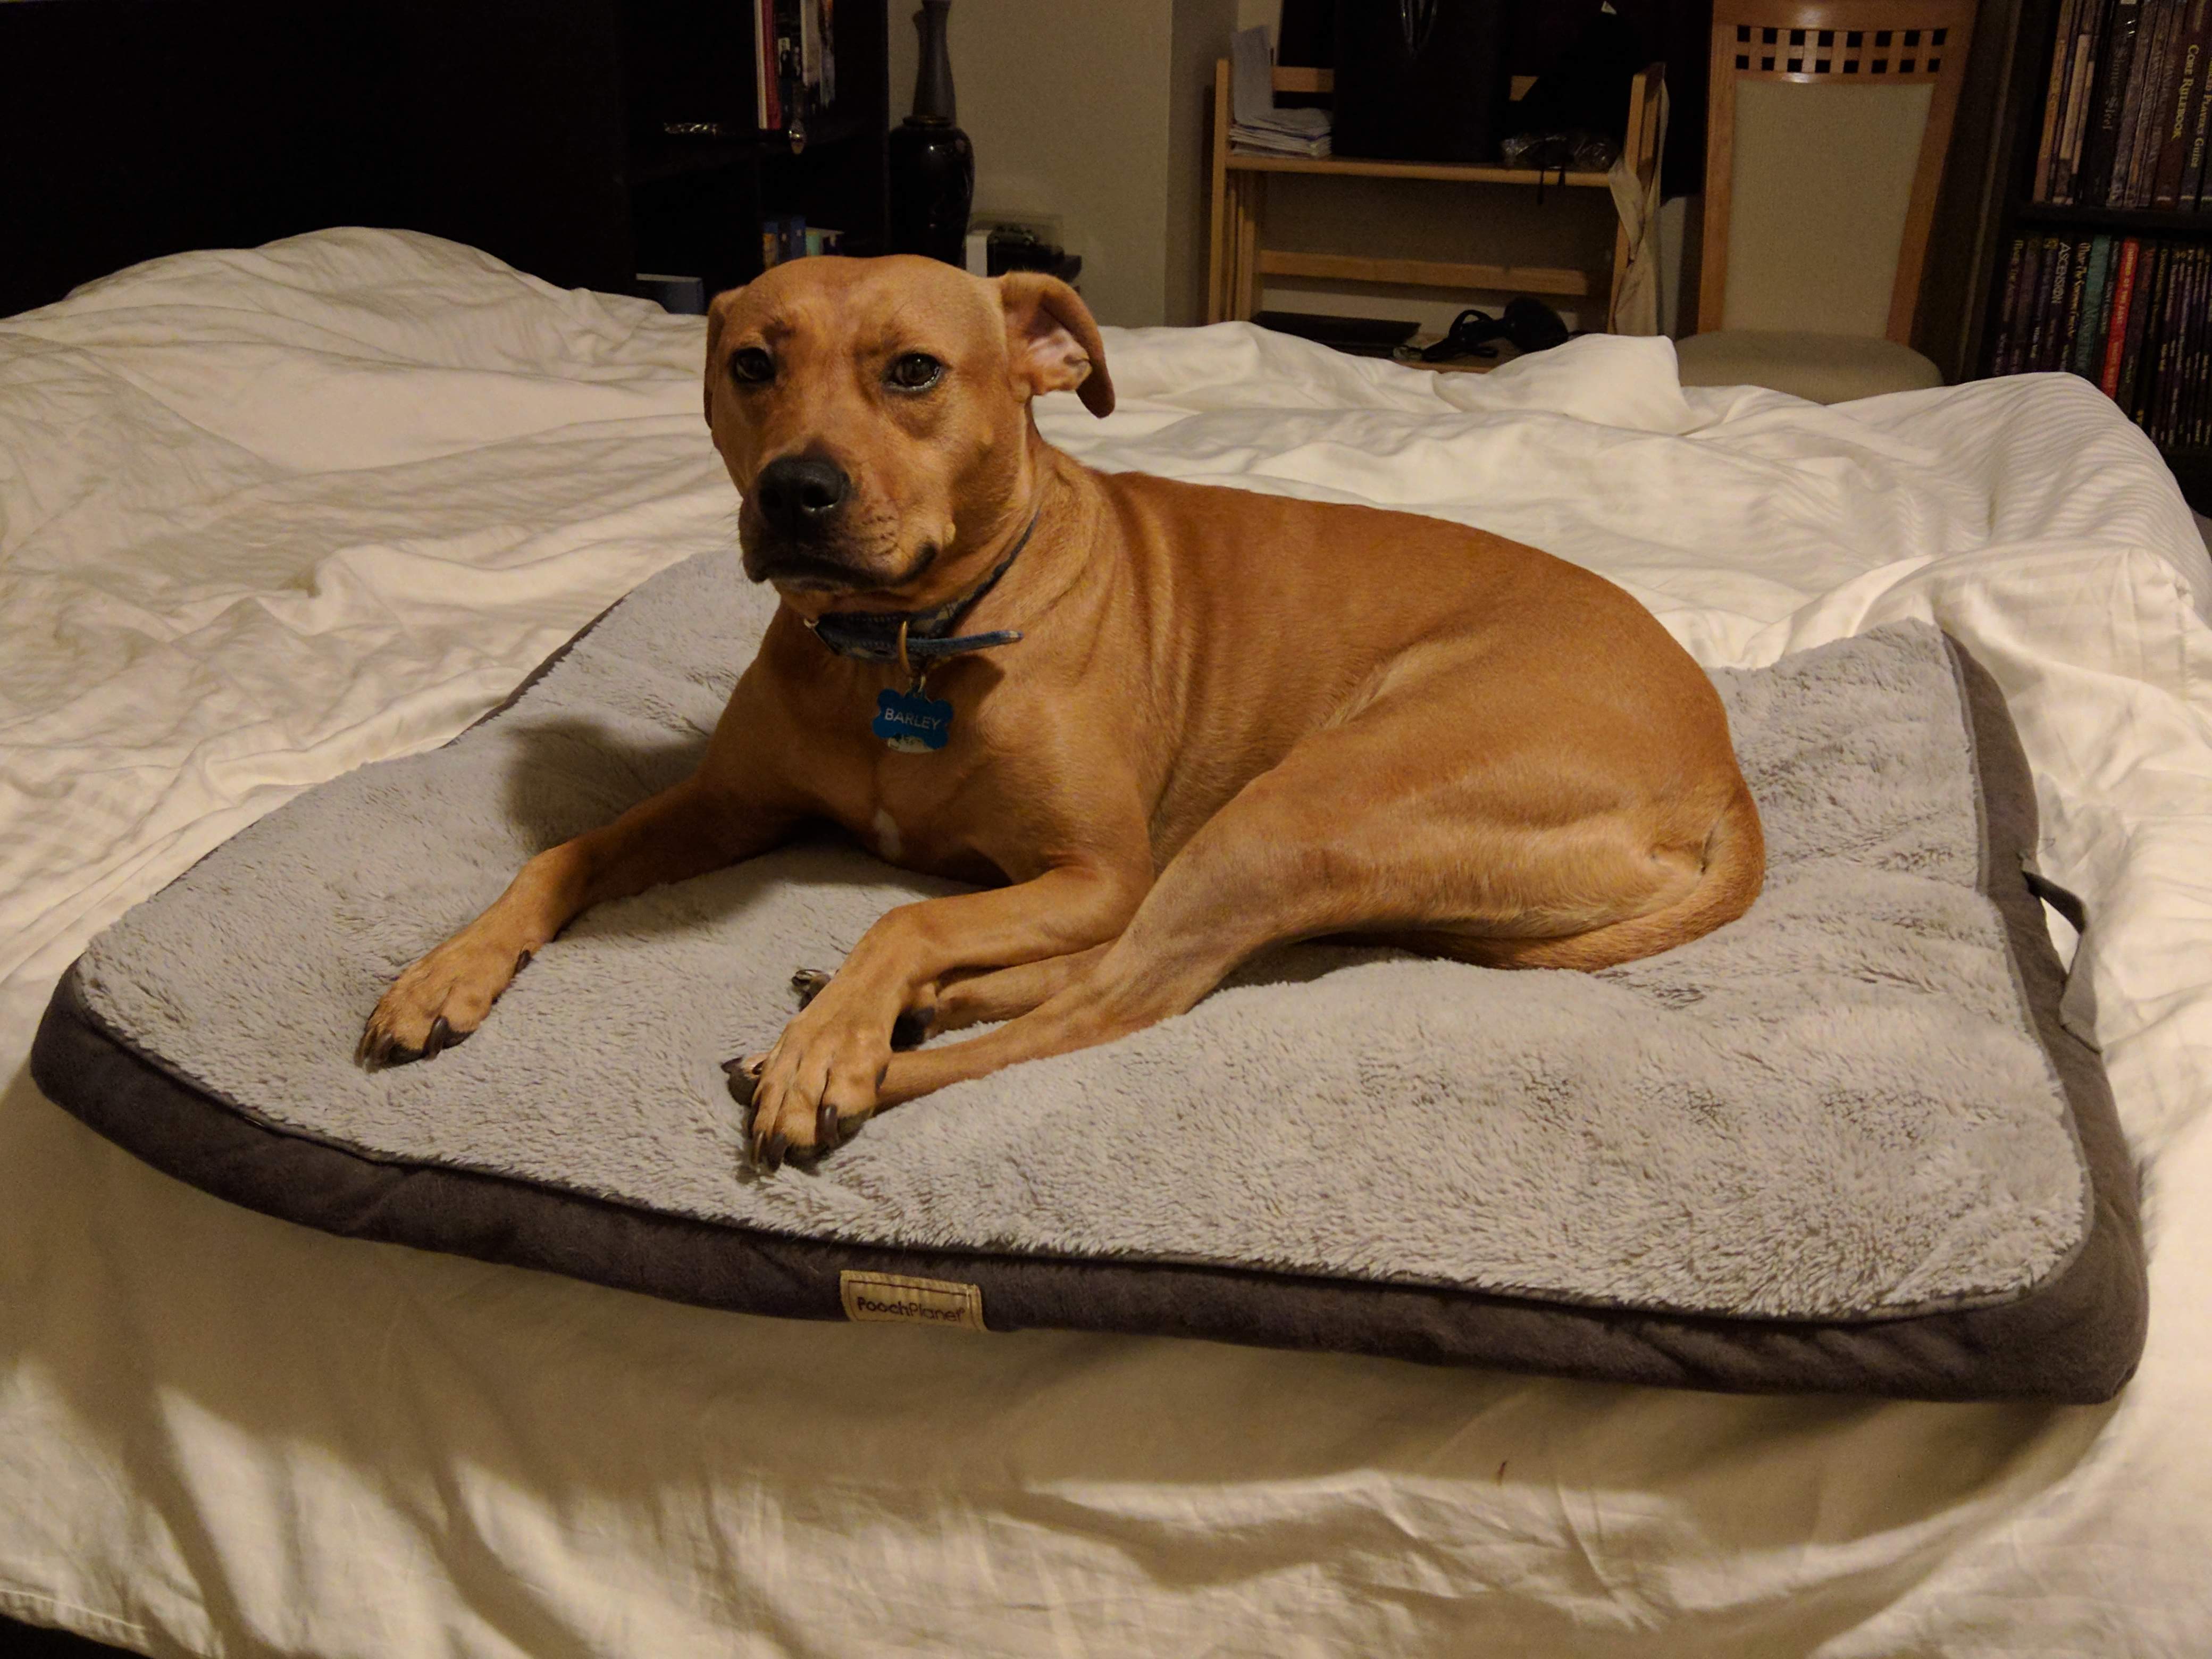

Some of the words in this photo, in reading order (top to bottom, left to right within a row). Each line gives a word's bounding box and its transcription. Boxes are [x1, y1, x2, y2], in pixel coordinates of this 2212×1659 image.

[2171, 77, 2194, 141] RULEBOOK
[2051, 242, 2072, 304] ASCENSION
[884, 708, 941, 730] BARLEY
